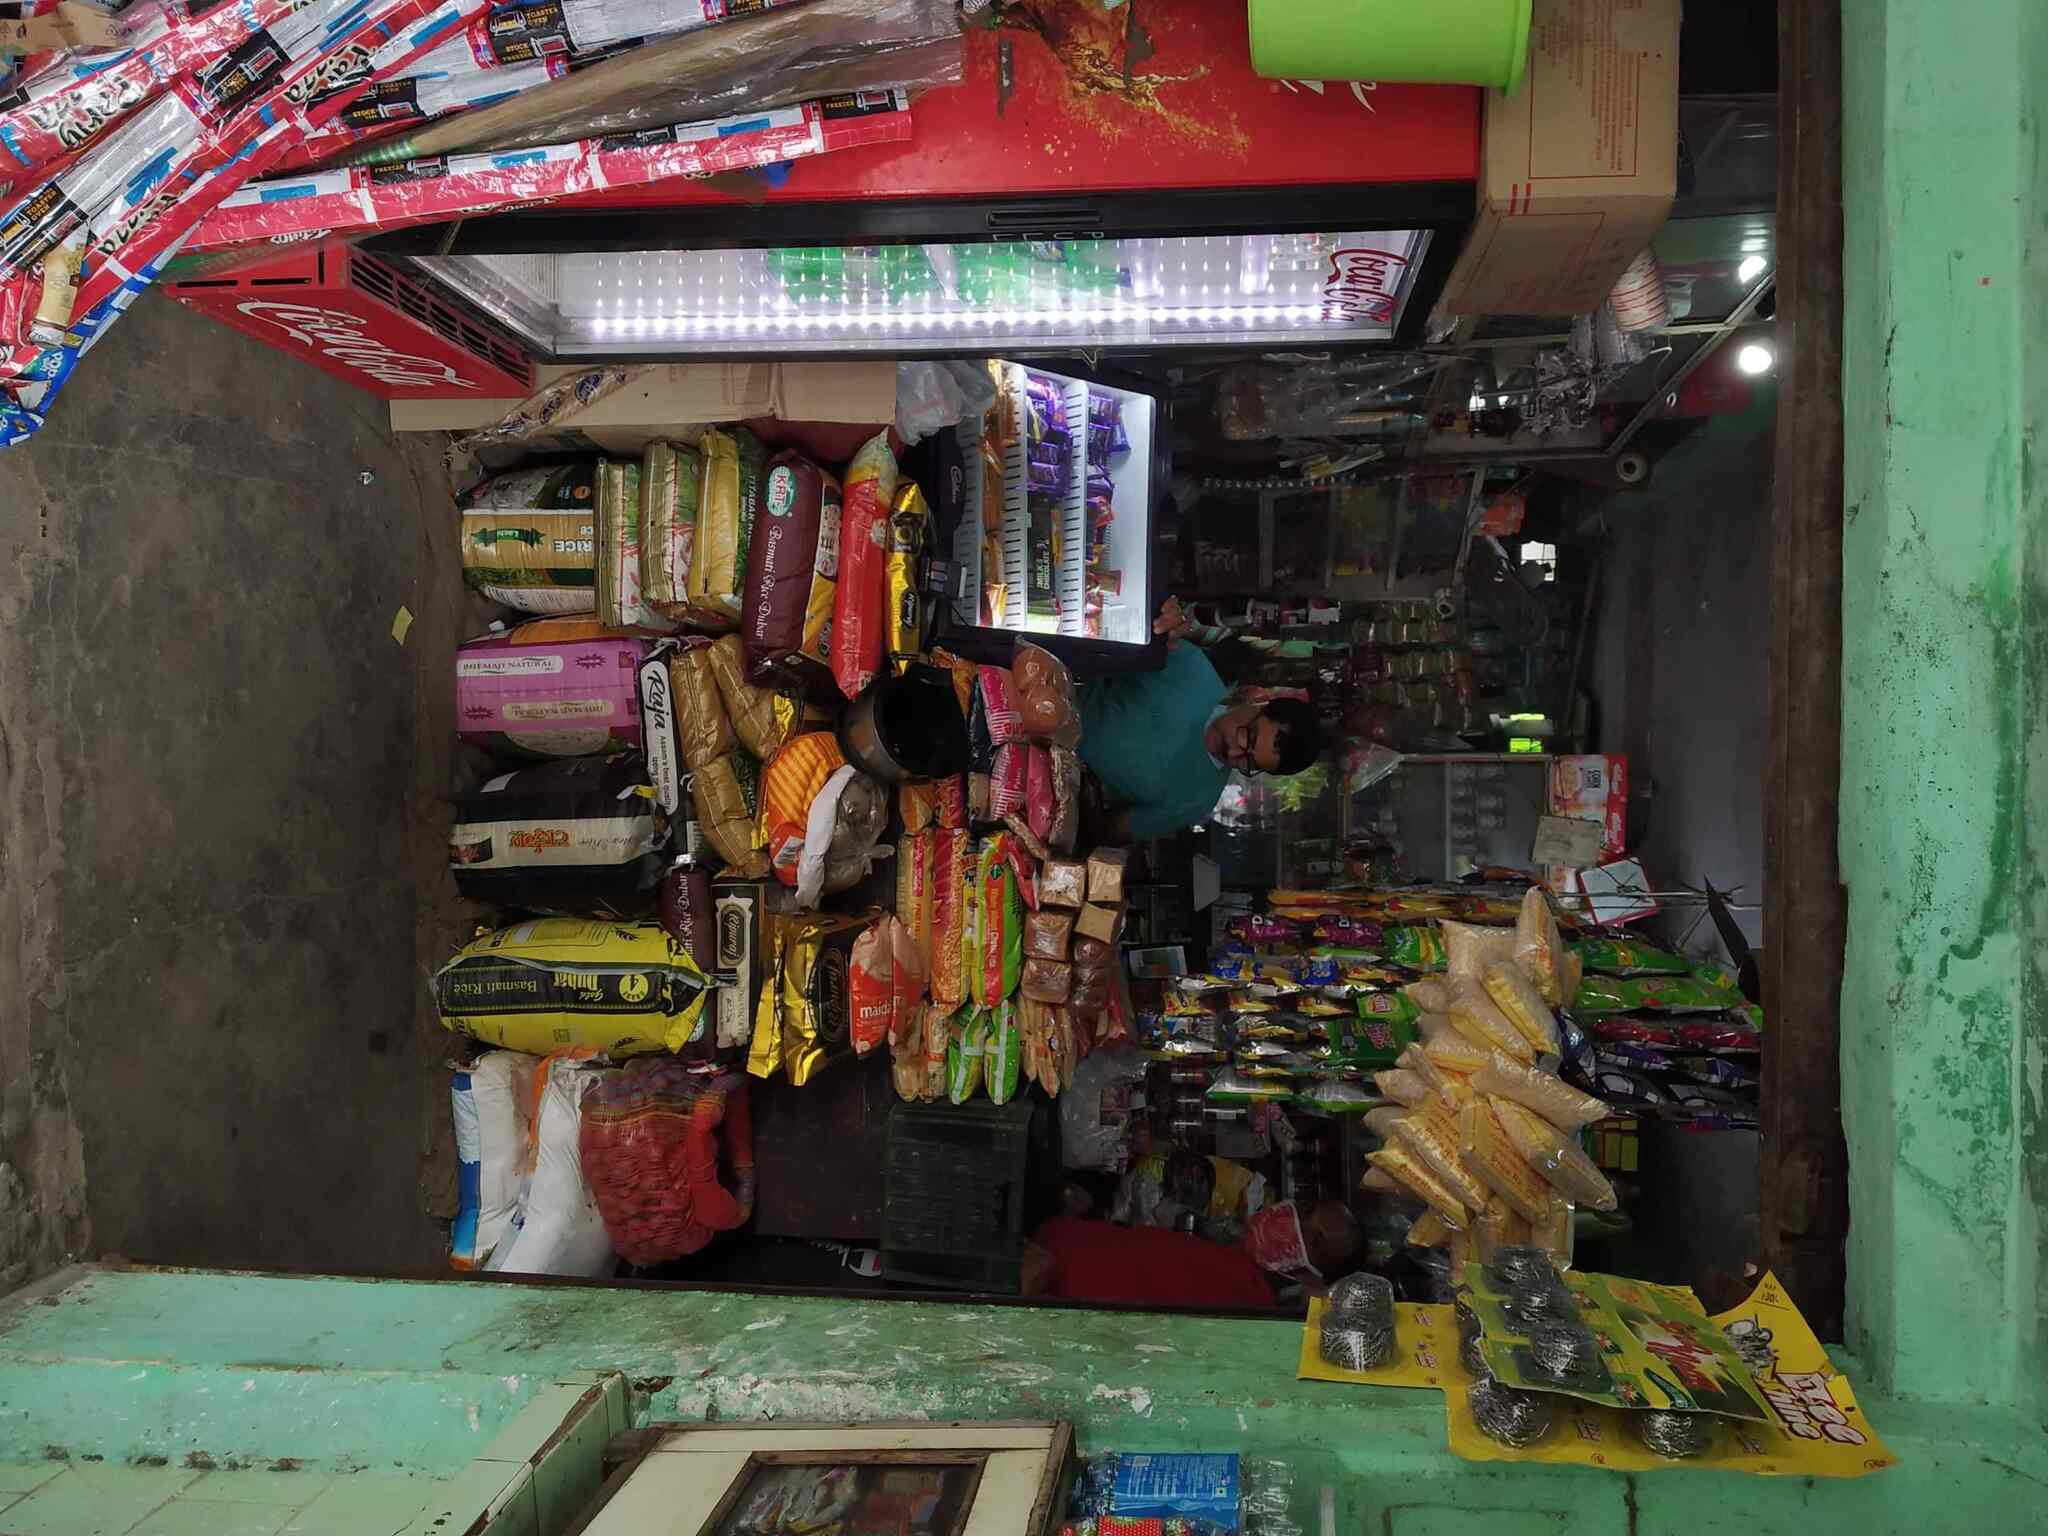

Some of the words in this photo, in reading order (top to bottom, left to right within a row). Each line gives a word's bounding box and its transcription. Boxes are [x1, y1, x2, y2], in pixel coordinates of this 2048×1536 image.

[1322, 249, 1408, 321] Coca-Cola
[237, 302, 478, 388] Coca-Cola
[764, 525, 783, 573] Basmati
[759, 575, 775, 600] Rice
[645, 669, 669, 730] Raja
[721, 912, 740, 958] Ripuraj
